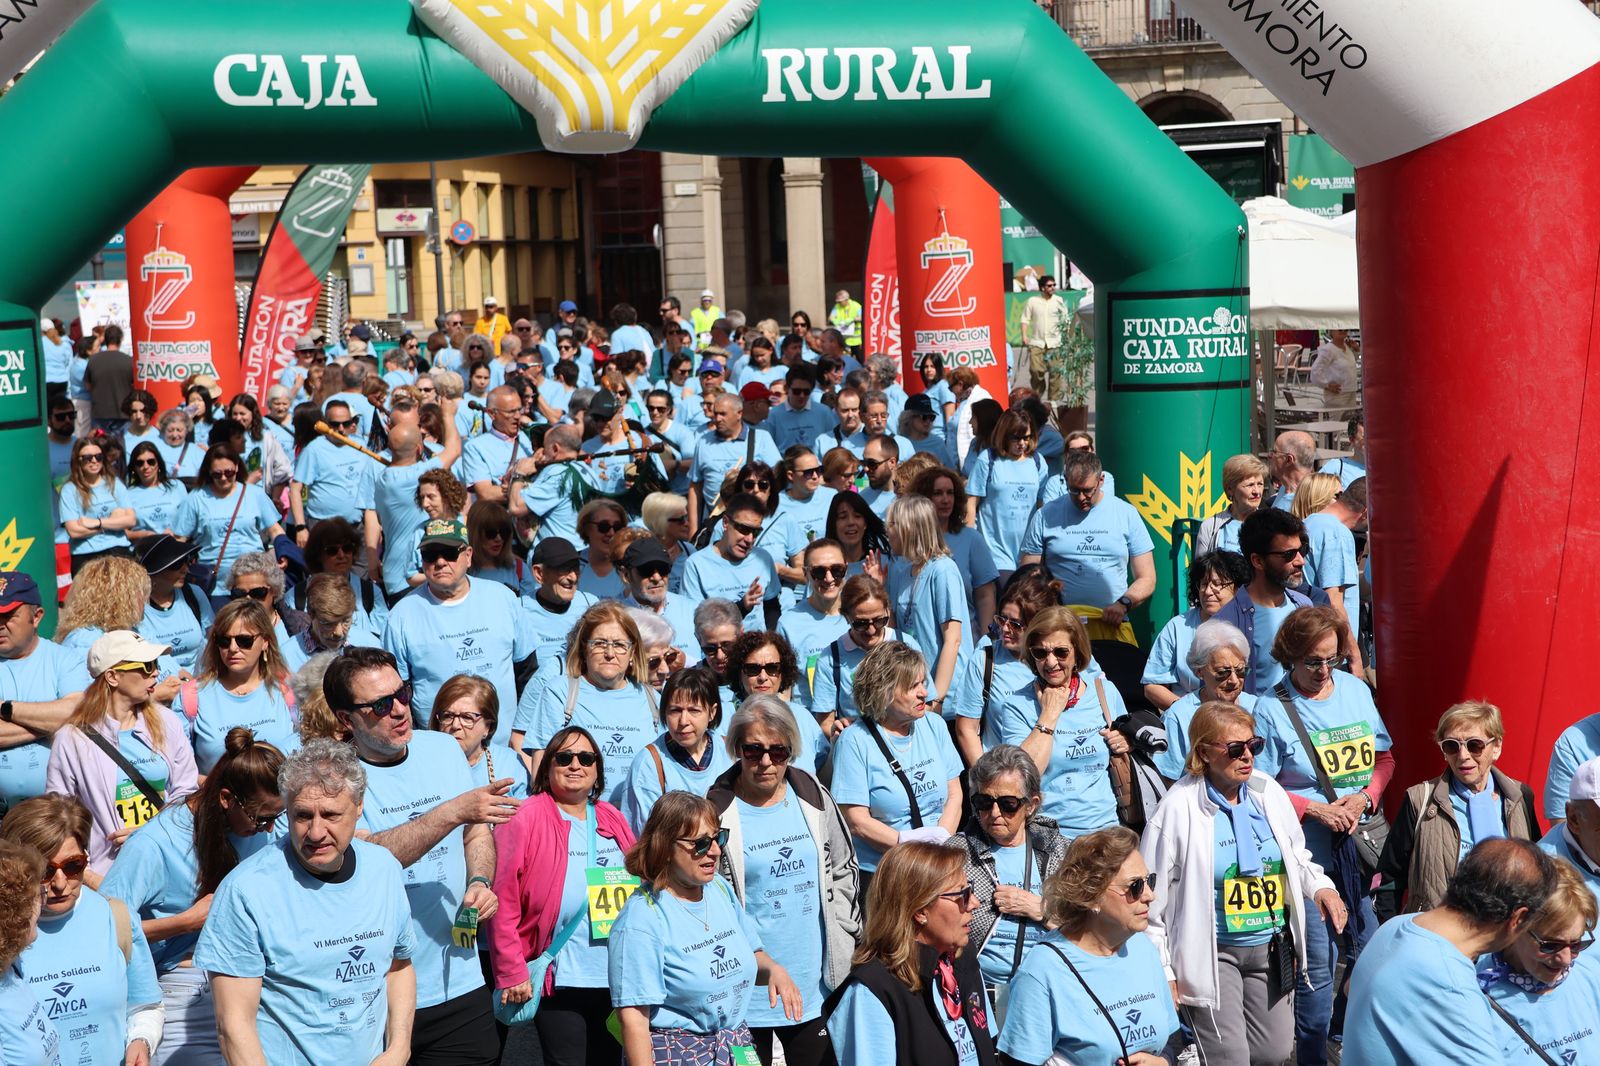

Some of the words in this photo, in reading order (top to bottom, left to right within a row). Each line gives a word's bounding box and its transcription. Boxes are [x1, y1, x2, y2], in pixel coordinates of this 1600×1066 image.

[1227, 0, 1336, 96] MORA
[213, 53, 378, 110] CAJA
[762, 45, 992, 103] RURAL
[1311, 177, 1331, 185] CAJA
[1123, 339, 1180, 361] CAJA
[1187, 336, 1247, 359] RURAL
[913, 348, 996, 370] ZMORA
[1124, 363, 1140, 374] DE
[1145, 362, 1204, 374] ZAMORA
[456, 647, 484, 661] AZAYCA
[602, 741, 634, 757] AZAYCA
[1065, 745, 1097, 760] AZAYCA
[1324, 742, 1372, 774] 926
[911, 780, 938, 798] ZAYCA
[411, 794, 442, 809] Solidaria
[758, 840, 782, 849] Marcha
[770, 859, 805, 877] AZAYCA
[1228, 880, 1277, 911] 468
[314, 940, 323, 949] VI
[324, 936, 353, 947] Marcha
[682, 946, 691, 954] VI
[691, 937, 715, 951] Marcha
[61, 964, 102, 979] Solidaria
[335, 960, 376, 983] AZAYCA
[710, 957, 741, 980] AZAYCA
[1128, 991, 1156, 1005] Solidaria
[43, 997, 88, 1020] ZAYCA
[1120, 1025, 1157, 1048] ZAYCA
[1538, 1039, 1563, 1051] archa
[1563, 1028, 1593, 1044] Solidaria
